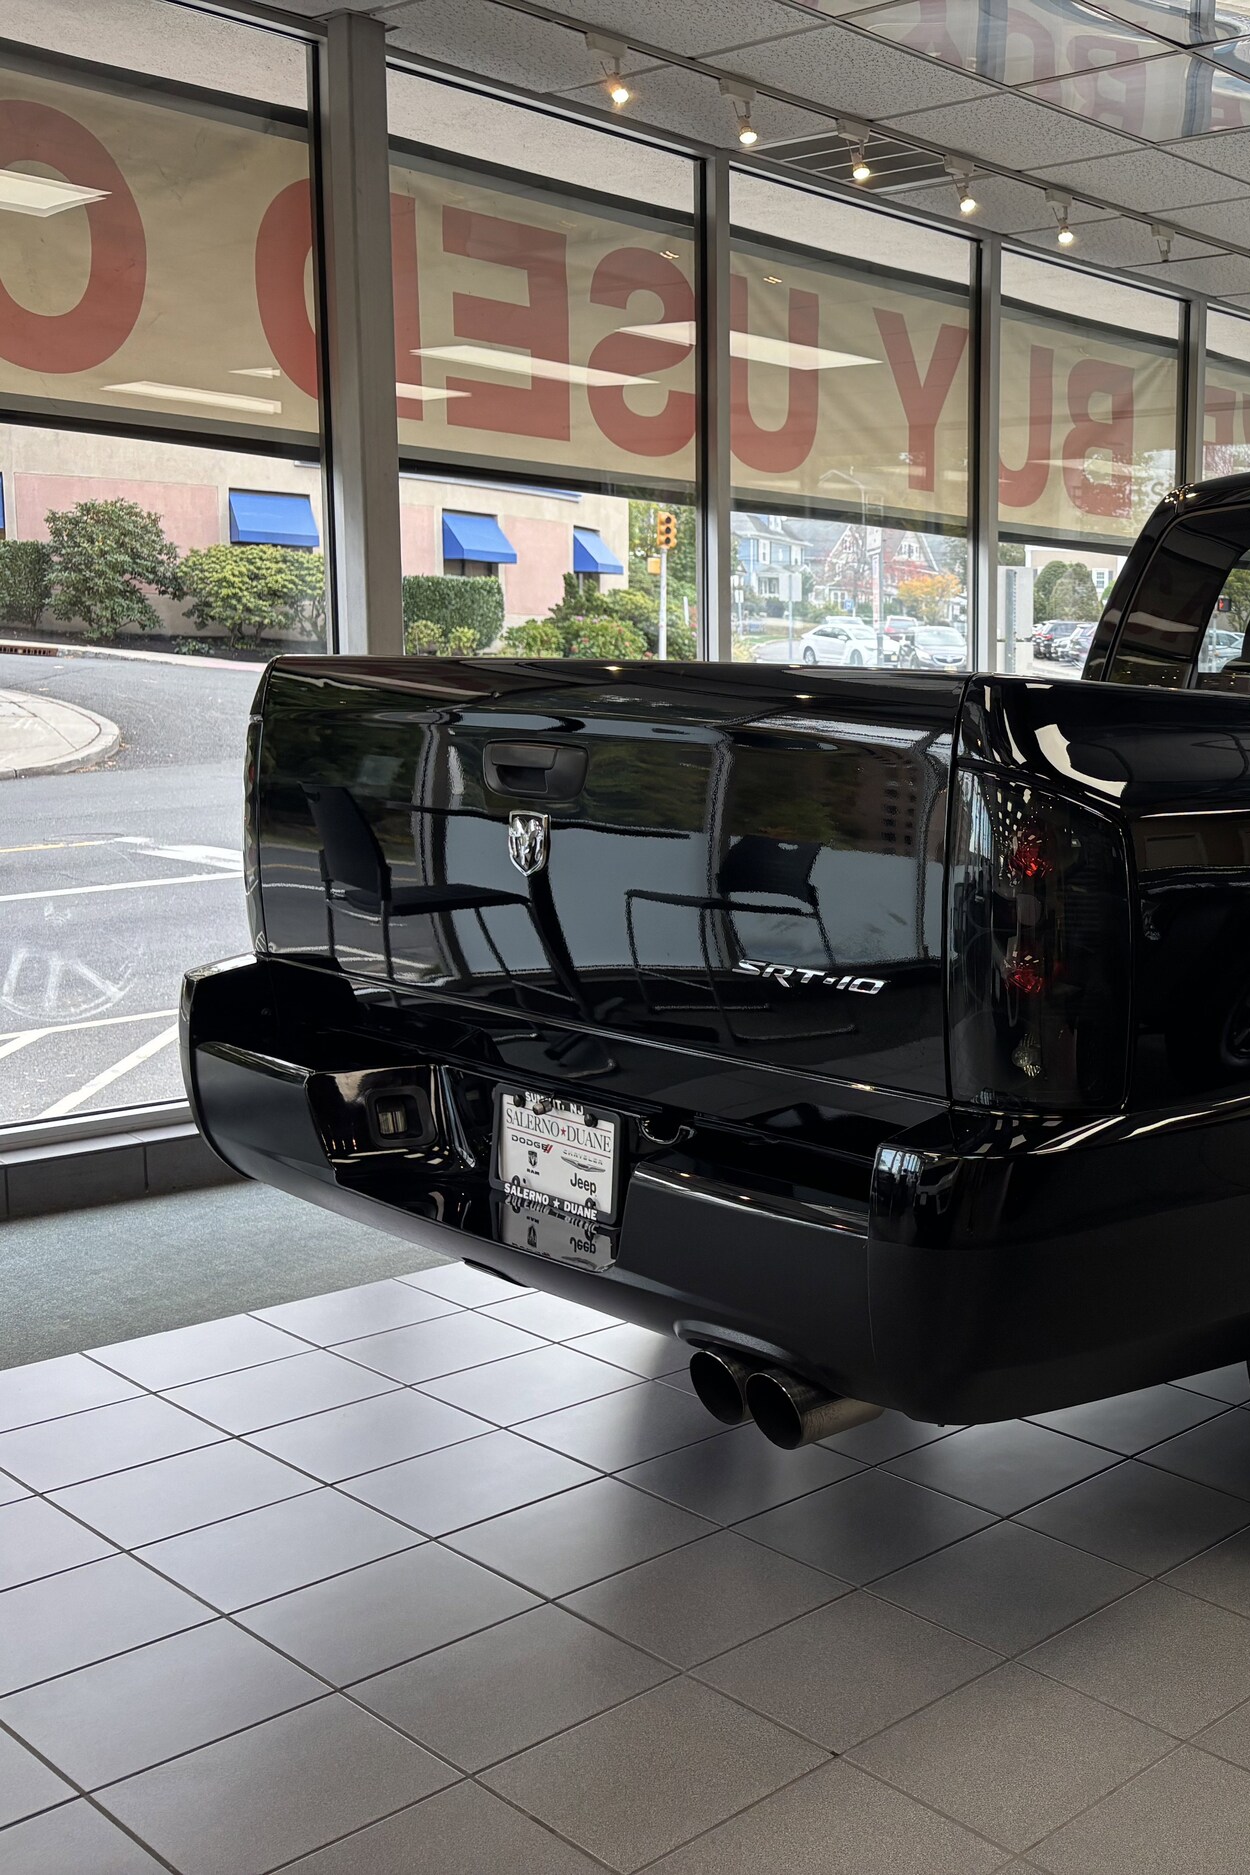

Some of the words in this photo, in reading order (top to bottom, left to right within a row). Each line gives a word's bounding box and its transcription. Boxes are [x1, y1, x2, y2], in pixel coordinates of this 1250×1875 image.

[731, 959, 887, 995] SRT-10
[525, 1091, 565, 1110] SUMIT,
[570, 1103, 584, 1115] NJ
[506, 1108, 560, 1138] SALERNO
[567, 1125, 612, 1153] DUANE
[511, 1134, 548, 1150] DODGE
[570, 1172, 597, 1196] Jeep
[504, 1183, 549, 1205] SALERNO
[563, 1201, 598, 1220] DUANE
